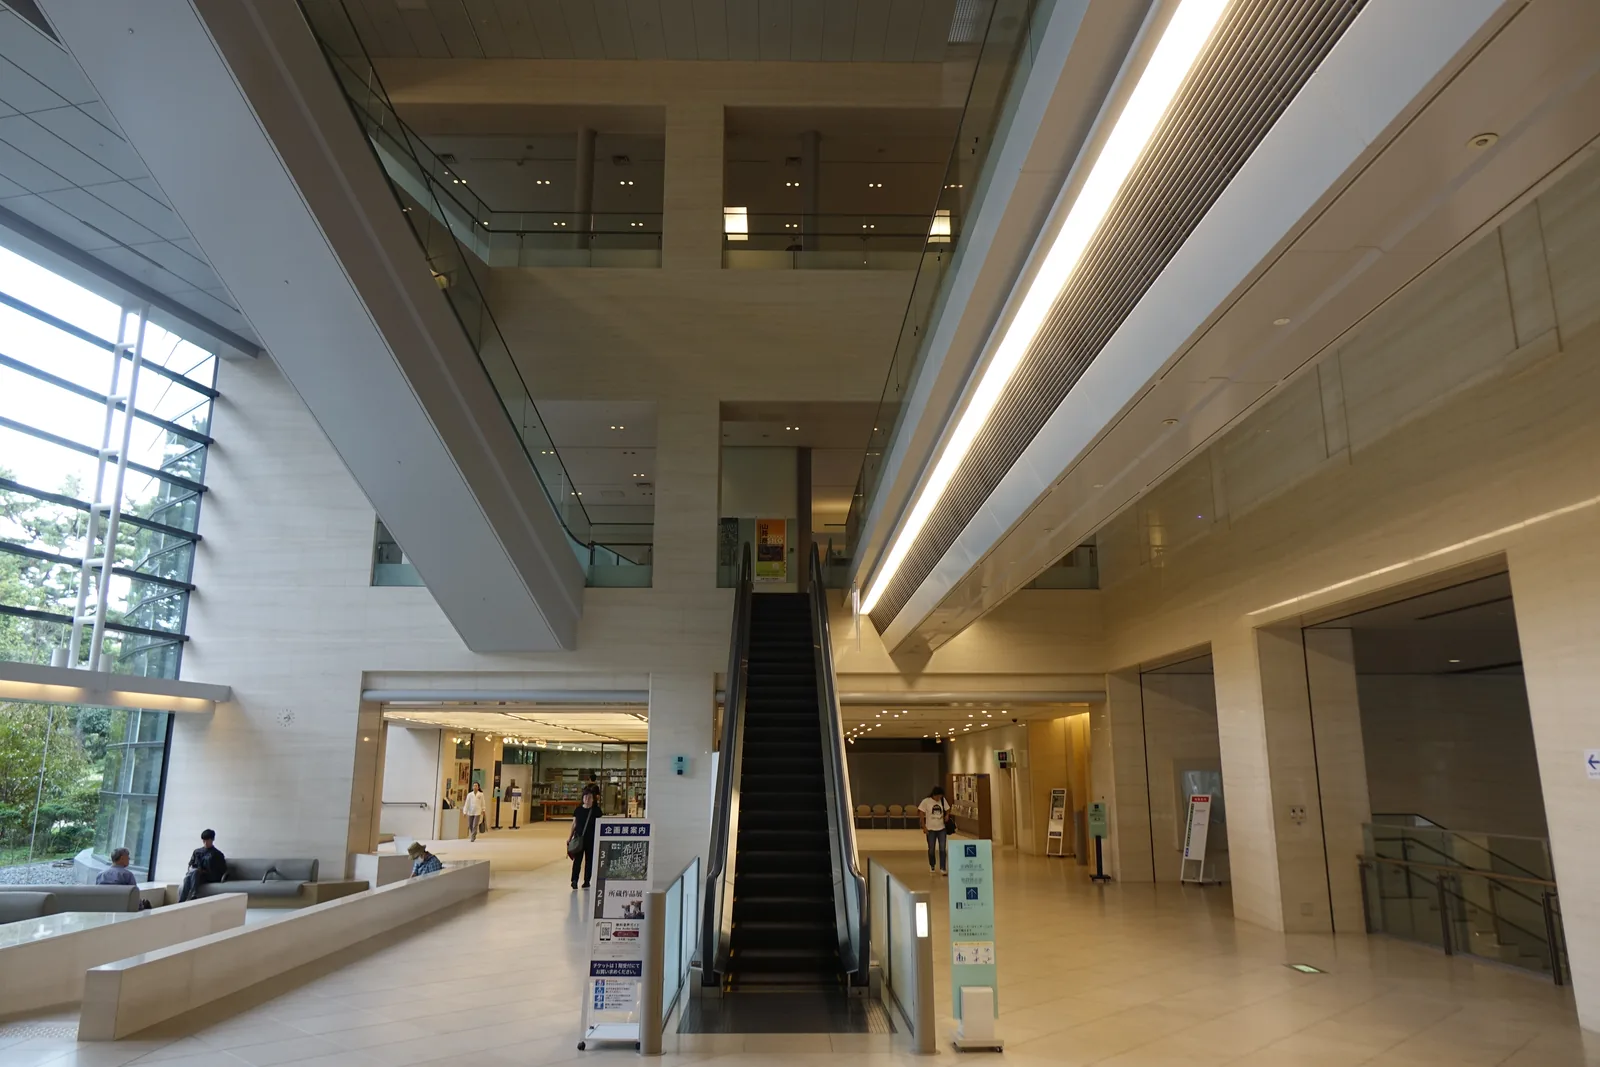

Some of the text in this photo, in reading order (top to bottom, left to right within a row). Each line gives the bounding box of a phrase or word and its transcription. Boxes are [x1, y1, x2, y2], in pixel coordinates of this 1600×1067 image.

[604, 826, 646, 834] 企画展案内
[608, 889, 643, 898] 所蔵作品展
